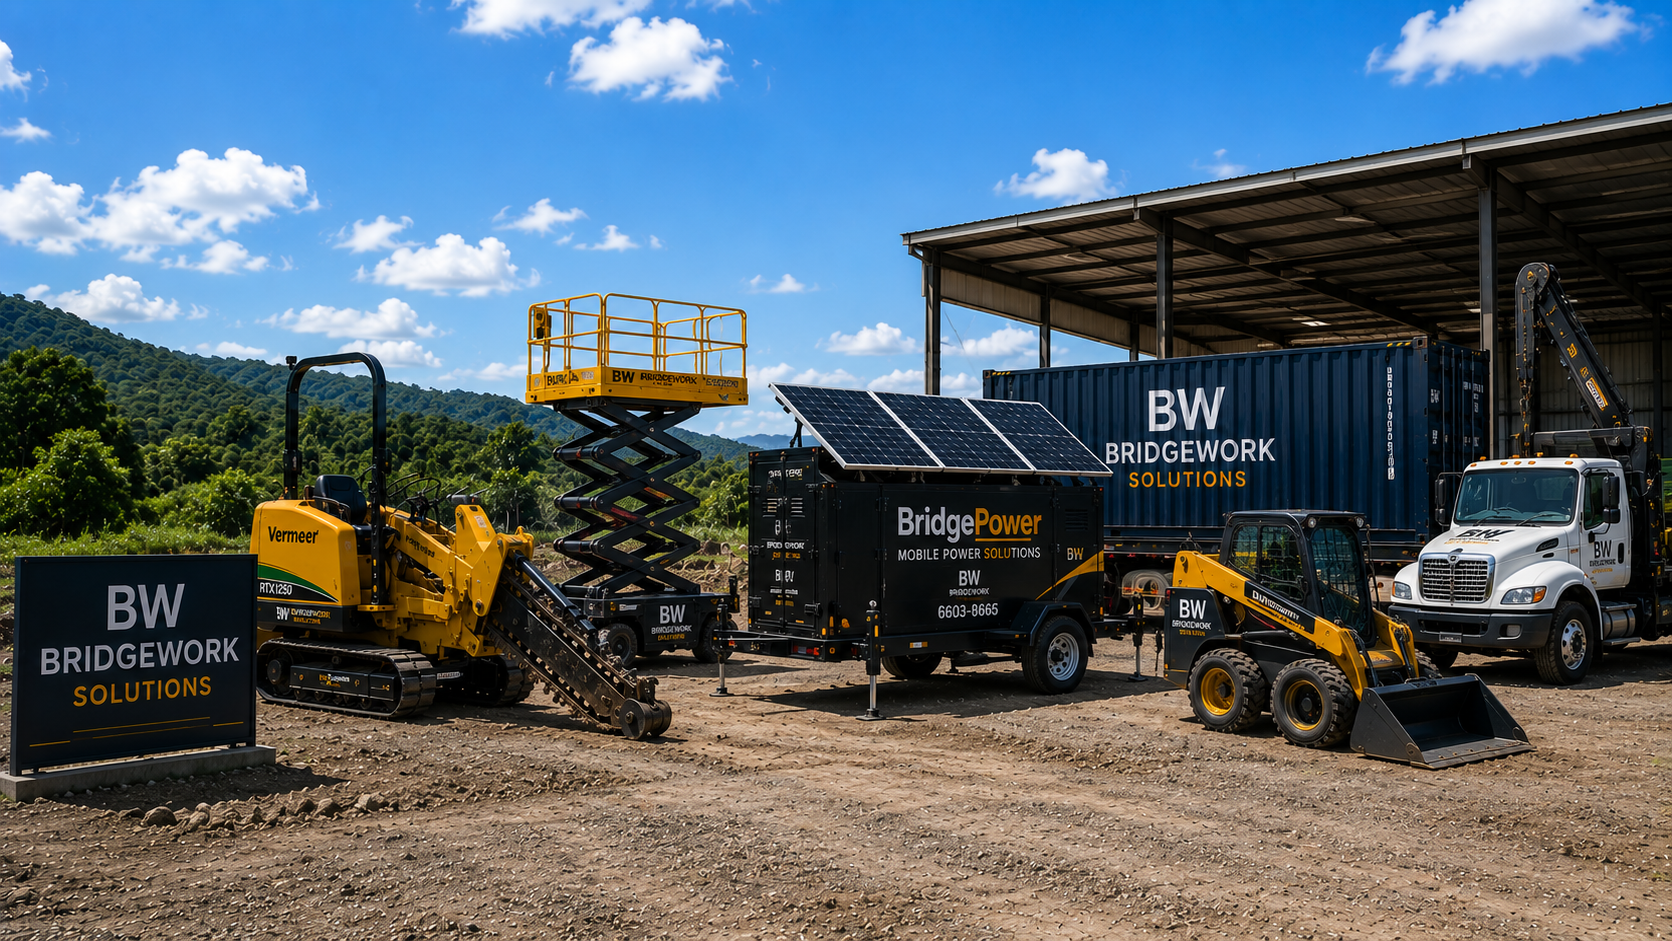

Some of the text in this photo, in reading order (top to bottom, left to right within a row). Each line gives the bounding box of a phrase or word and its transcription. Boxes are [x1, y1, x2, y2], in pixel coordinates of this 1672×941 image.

[612, 370, 635, 384] BW
[1148, 386, 1226, 432] BW
[1105, 438, 1276, 464] BRIDGEWORK
[1128, 470, 1246, 488] SOLUTIONS
[897, 506, 1042, 543] BridgePower
[268, 526, 319, 544] Vermeer
[897, 546, 1041, 561] MOBILE POWER SOLUTIONS
[1067, 547, 1084, 560] BW
[1593, 540, 1613, 559] BW
[958, 570, 981, 586] BW
[107, 583, 185, 630] BW
[659, 605, 686, 624] BW
[938, 603, 999, 619] 6603-8665
[1179, 599, 1206, 620] BW
[41, 637, 240, 675] BRIDGEWORK
[73, 676, 211, 707] SOLUTIONS
